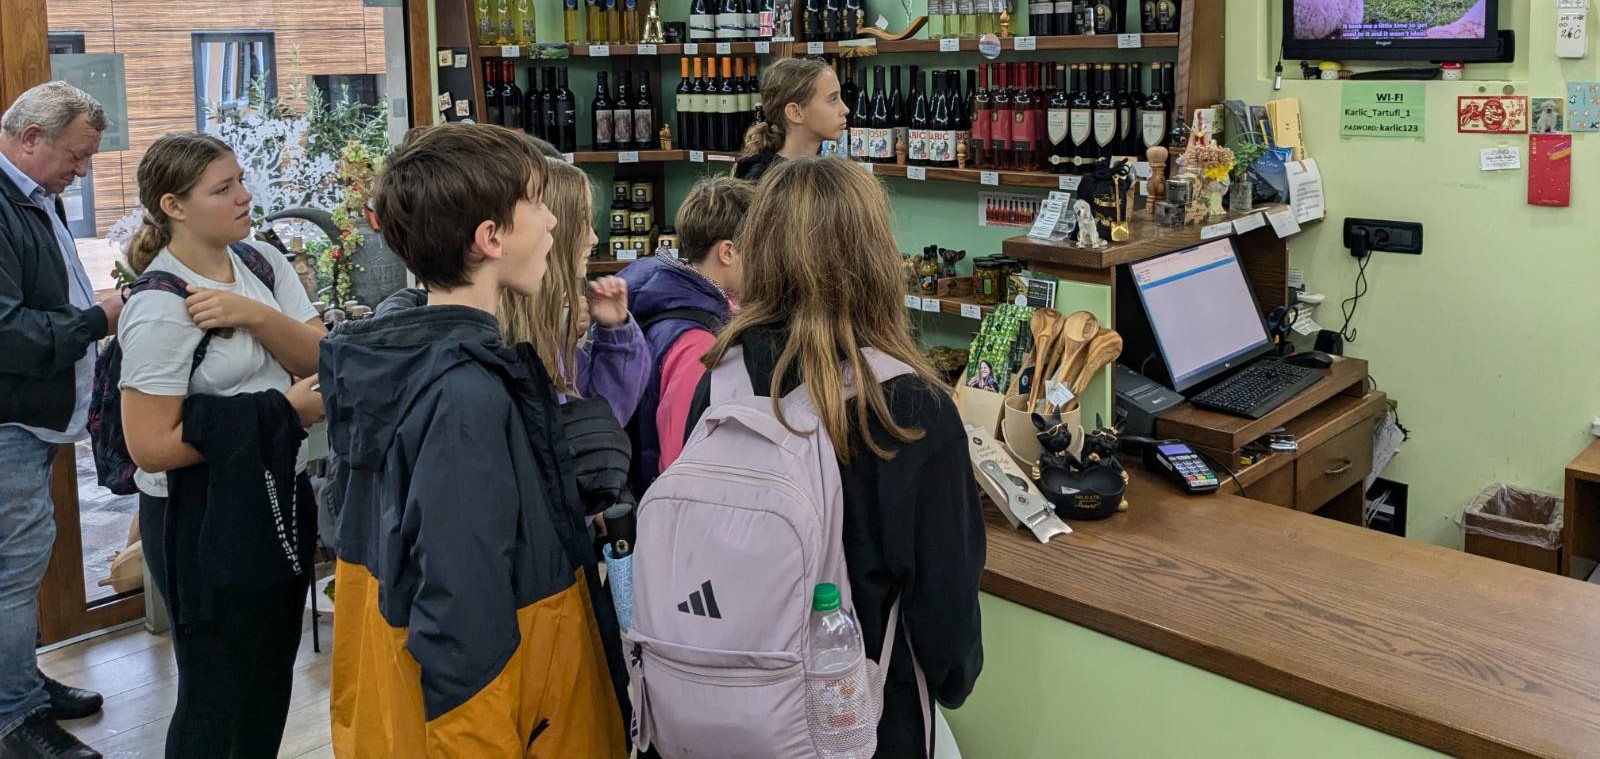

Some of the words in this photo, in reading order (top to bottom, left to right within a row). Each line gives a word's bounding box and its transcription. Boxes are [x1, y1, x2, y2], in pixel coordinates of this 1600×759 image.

[1376, 93, 1404, 102] WI-FI
[1344, 109, 1410, 118] Karlic_Tartufi_1
[1380, 123, 1419, 132] karlic123
